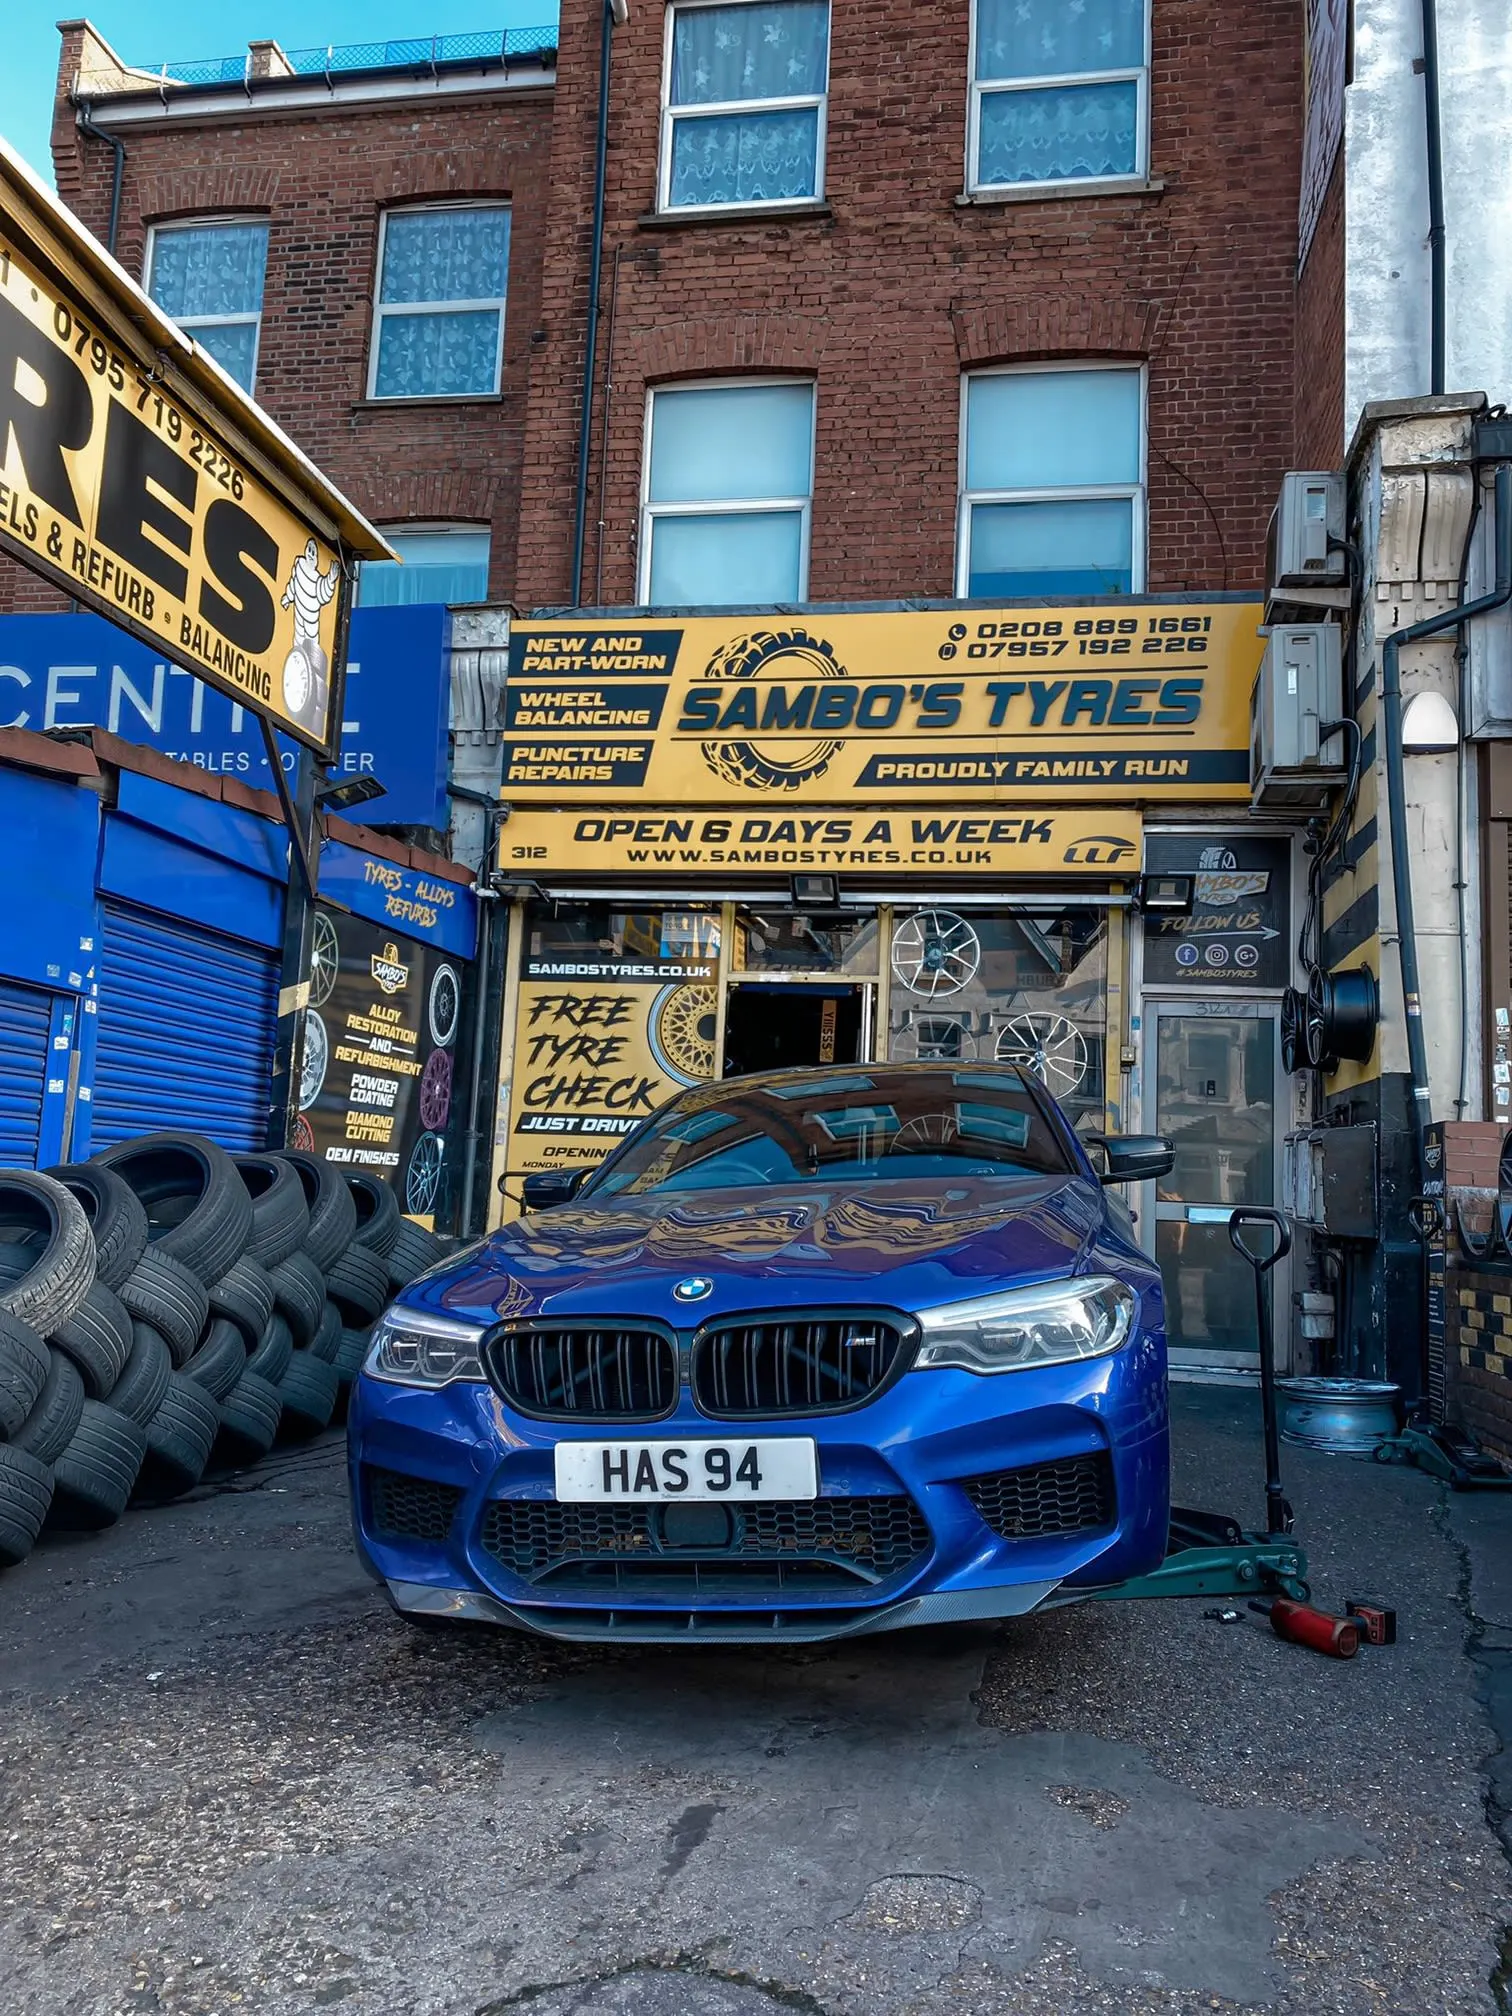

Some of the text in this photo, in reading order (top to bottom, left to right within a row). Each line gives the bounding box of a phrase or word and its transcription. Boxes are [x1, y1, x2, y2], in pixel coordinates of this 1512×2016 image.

[54, 302, 125, 391] 0795
[137, 377, 182, 442] 719
[191, 430, 246, 501] 2226
[47, 523, 62, 557] &
[72, 541, 155, 622] REFURB
[181, 612, 272, 703] BALANCING
[977, 616, 1211, 638] 0208 889 1661
[526, 637, 642, 652] NEW AND
[967, 637, 1207, 658] 07957 192 226
[522, 655, 666, 671] PART-WORN
[520, 692, 606, 707] WHEEL
[677, 679, 1203, 731] SAMBO'S TYRES
[514, 710, 650, 726] BALANCING
[512, 747, 645, 762] PUNCTURE
[508, 765, 613, 781] REPAIRS
[876, 759, 1188, 779] PROUDLY FAMILY RUN
[574, 819, 1055, 843] OPEN 6 DAYS A WEEK
[511, 846, 548, 859] 312
[627, 849, 991, 864] WWW.SAMBOSTYRES.CO.UK
[365, 860, 402, 891] TYRES
[384, 893, 437, 928] REFURBS
[1160, 910, 1261, 932] FOLLOW US
[529, 963, 711, 977] SAMBOSTYRES.CO.UK
[369, 1003, 401, 1023] ALLOY
[524, 992, 640, 1029] FREE
[347, 1013, 417, 1044] RESTORATION
[369, 1037, 392, 1053] AND
[525, 1033, 632, 1070] TYRE
[335, 1046, 422, 1076] REFURBISHMENT
[351, 1074, 399, 1094] POWDER
[522, 1071, 656, 1112] CHECK
[349, 1088, 394, 1108] COATING
[346, 1111, 394, 1130] DIAMOND
[521, 1117, 578, 1130] JUST
[345, 1124, 391, 1143] CUTTING
[326, 1147, 400, 1166] OEM FINISHES
[603, 1446, 763, 1493] HAS 94
